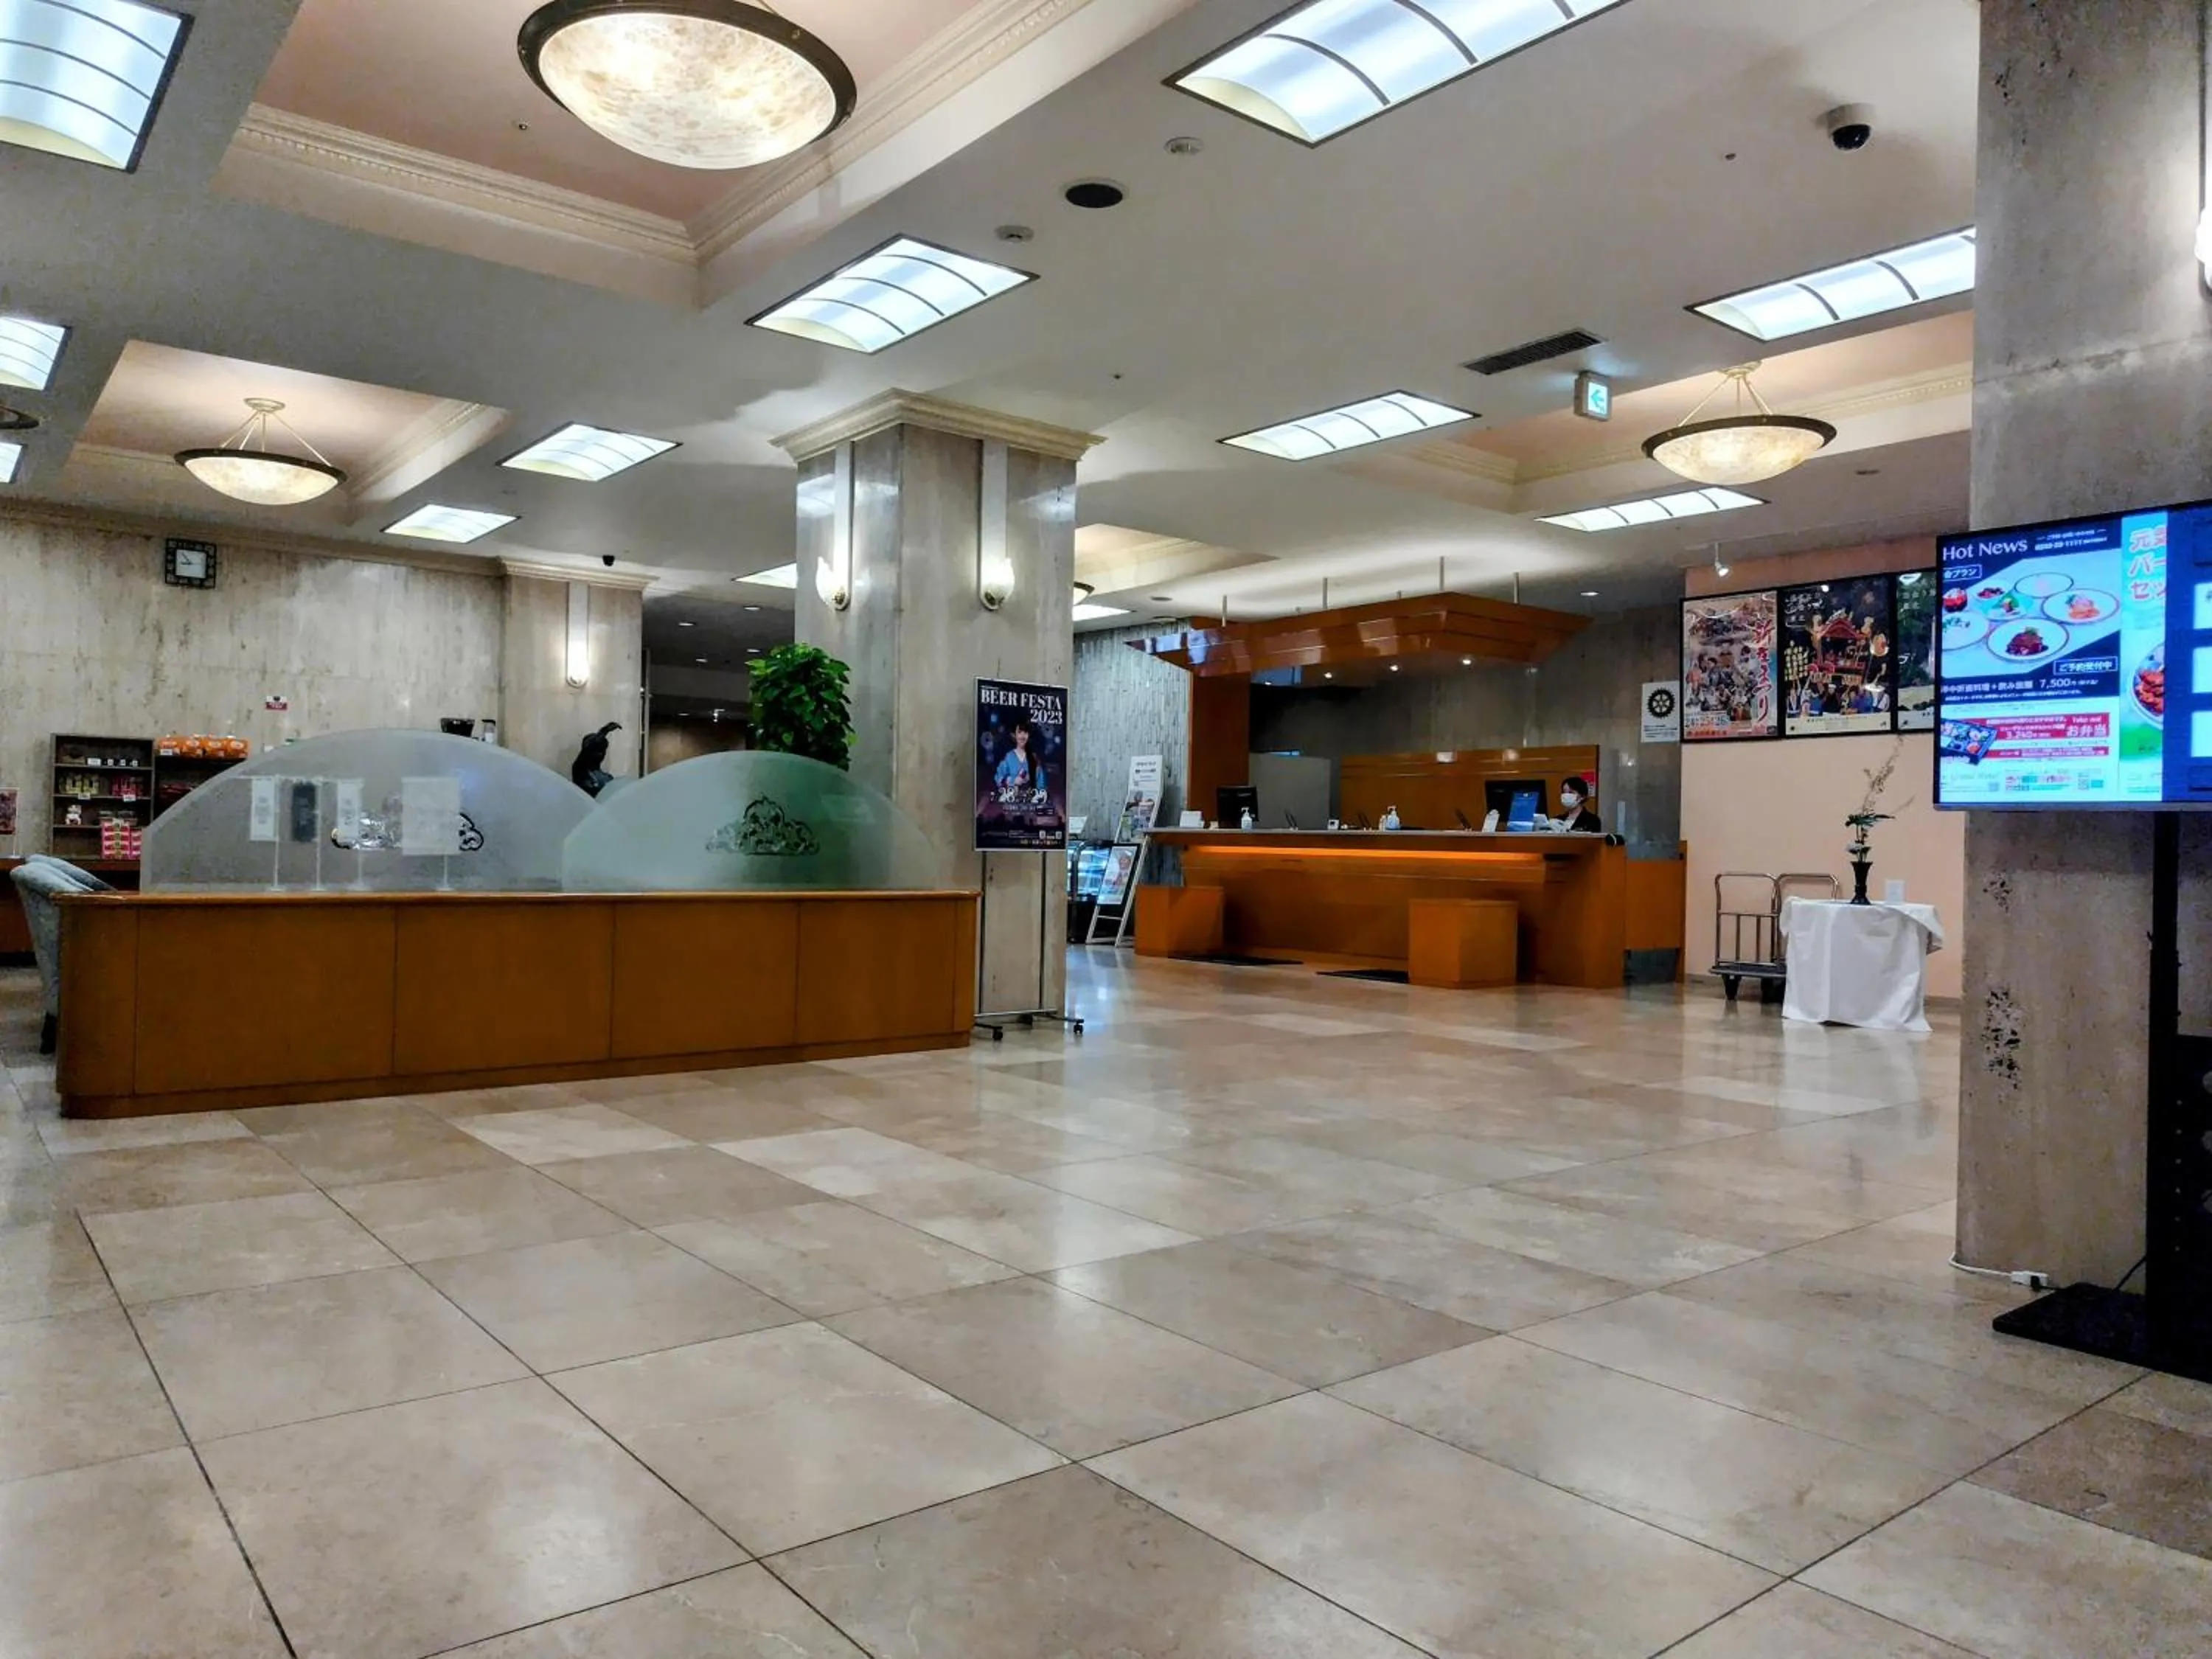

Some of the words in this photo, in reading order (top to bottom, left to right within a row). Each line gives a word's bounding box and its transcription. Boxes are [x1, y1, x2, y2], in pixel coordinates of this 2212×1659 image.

[1943, 543, 1973, 560] Hot
[1979, 540, 2028, 557] News
[981, 689, 1018, 706] BEER
[1020, 692, 1062, 710] FESTA
[1030, 709, 1062, 724] 2023
